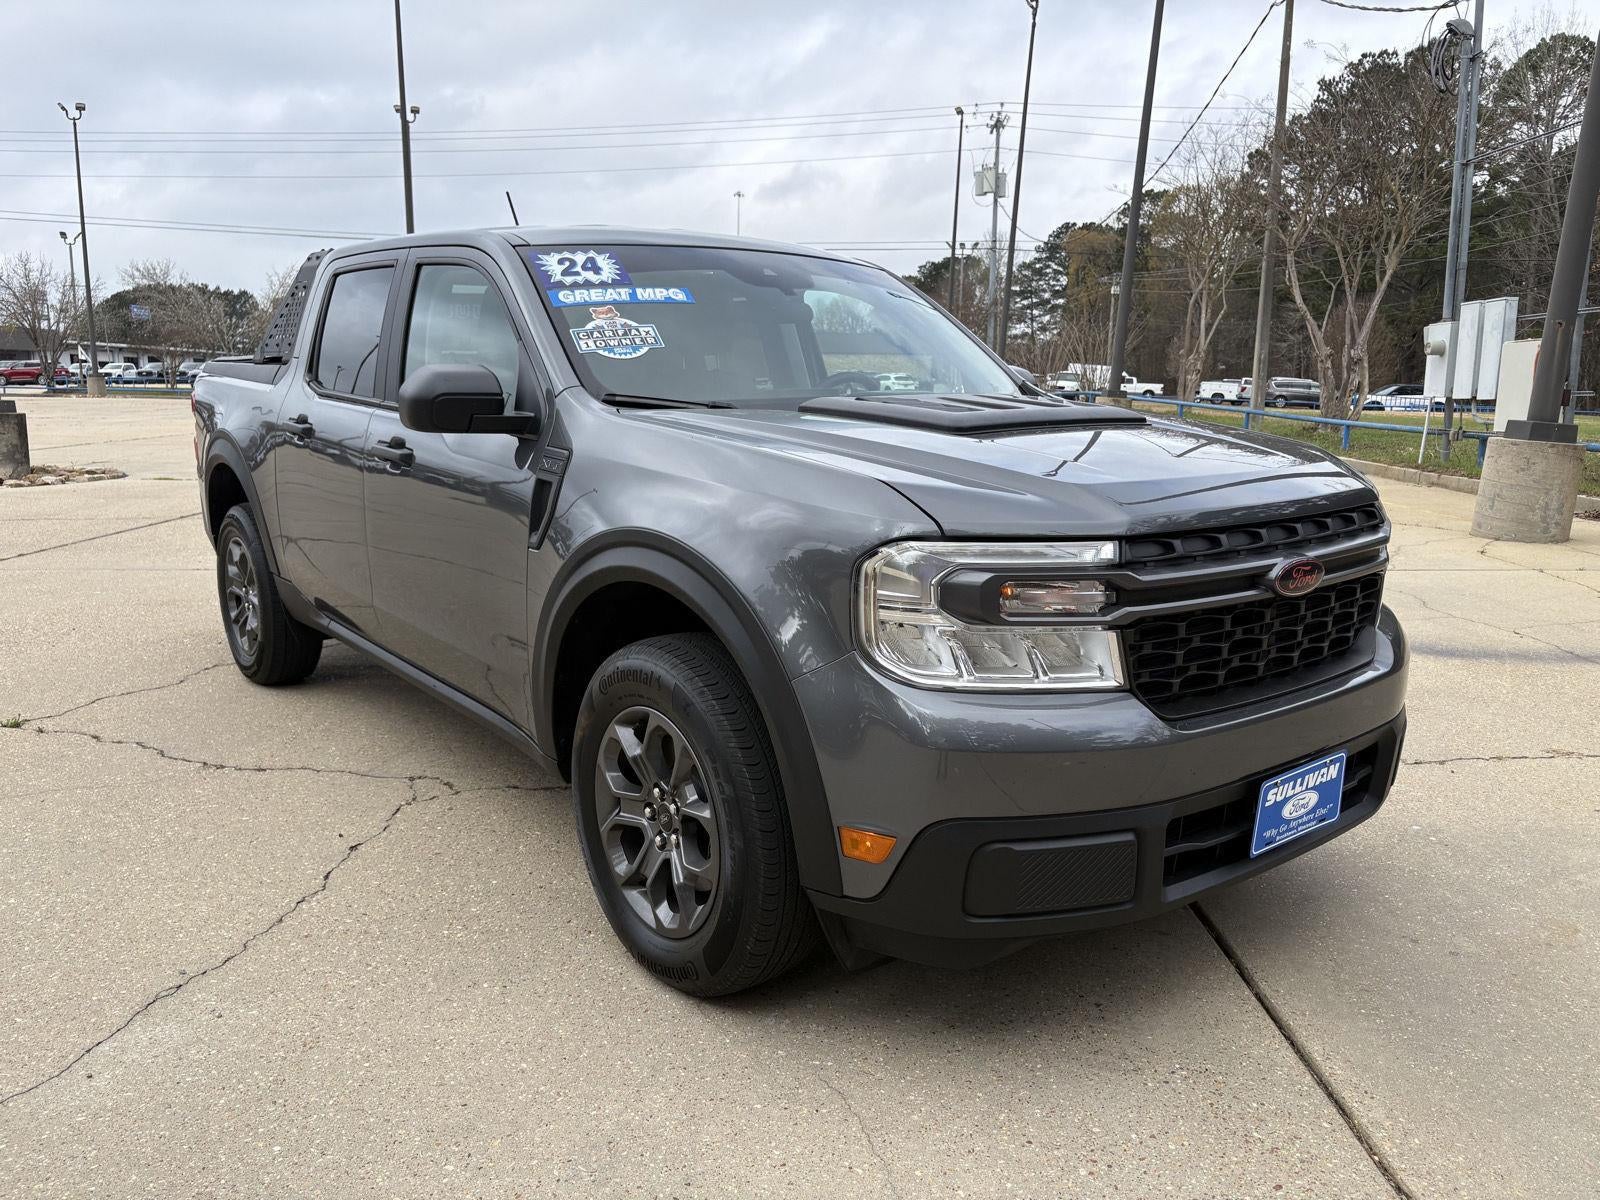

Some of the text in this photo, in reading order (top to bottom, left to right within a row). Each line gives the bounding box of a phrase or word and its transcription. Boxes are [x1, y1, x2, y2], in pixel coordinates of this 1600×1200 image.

[557, 256, 603, 277] 24
[558, 287, 686, 303] GREAT MPG
[578, 329, 652, 339] CARFAX
[583, 337, 656, 349] 1 OWNER
[1290, 566, 1317, 588] Ford
[598, 666, 654, 695] Continental
[1265, 763, 1340, 807] SULLIVAN
[1289, 796, 1311, 815] Ford
[1279, 824, 1288, 833] Go
